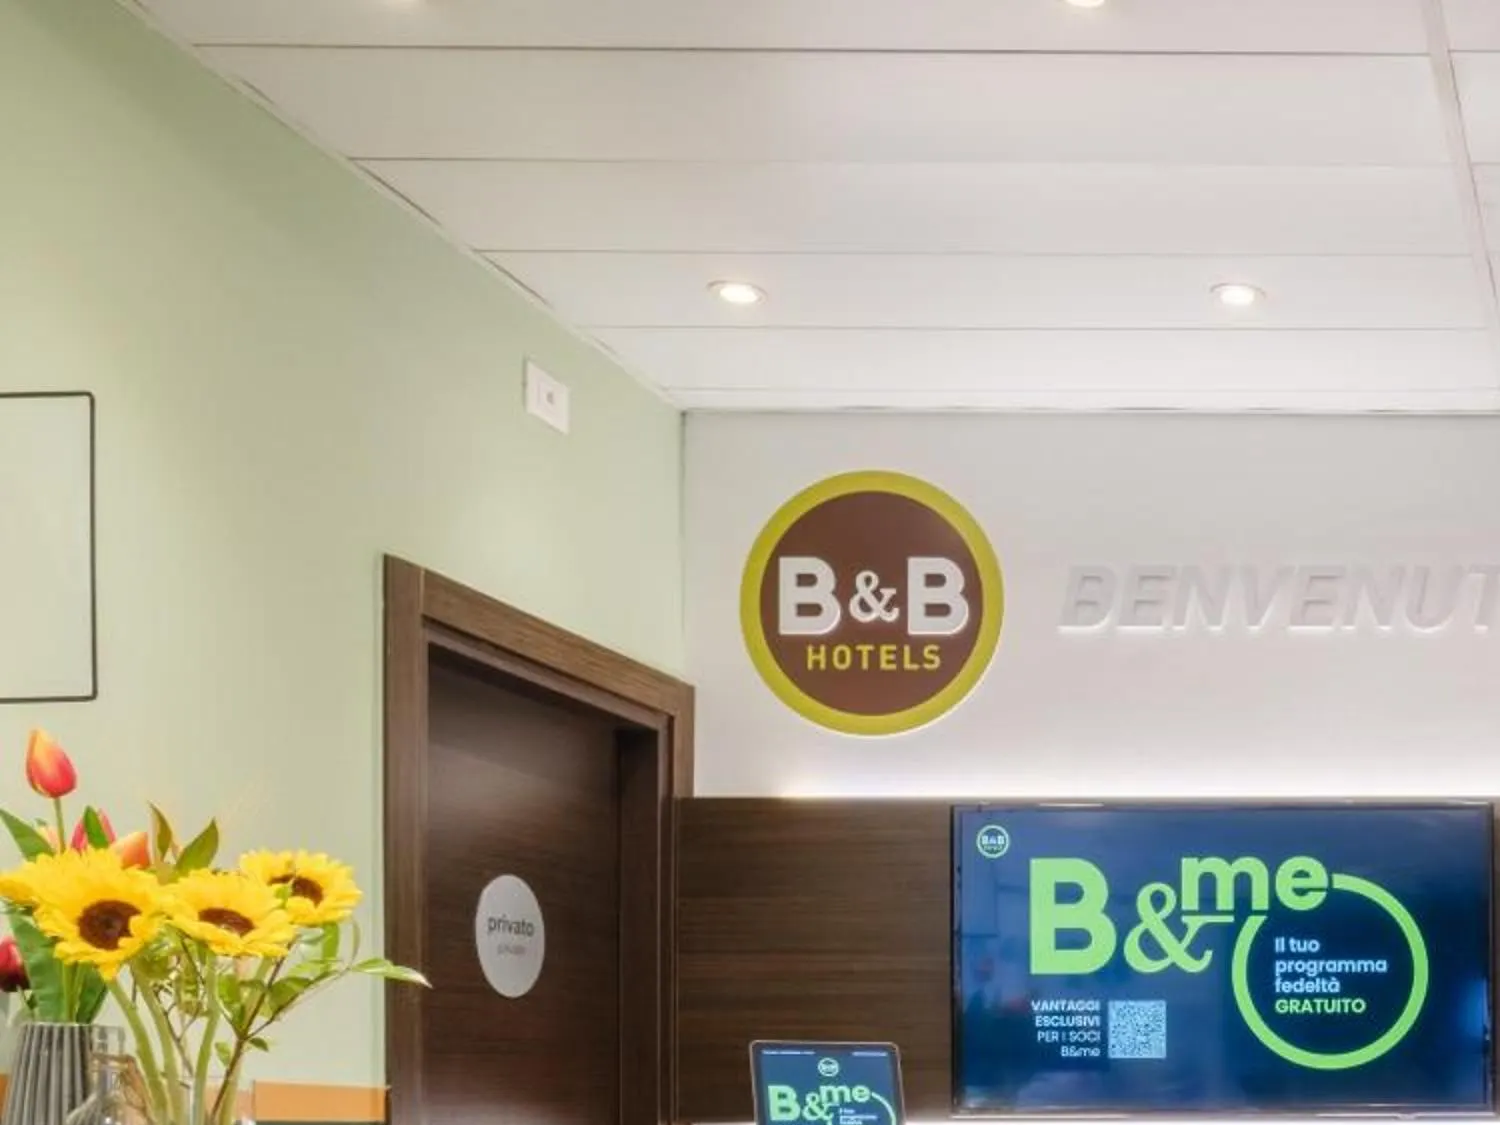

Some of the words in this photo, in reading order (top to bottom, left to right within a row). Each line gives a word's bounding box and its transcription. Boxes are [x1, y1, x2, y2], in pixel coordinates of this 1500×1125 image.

[777, 556, 971, 637] B&B
[805, 643, 942, 672] HOTELS
[1029, 856, 1329, 975] B&me
[487, 914, 535, 938] privato
[1274, 937, 1285, 953] Il
[1289, 937, 1320, 953] tuo
[1275, 959, 1388, 977] programma
[1274, 977, 1340, 993] fedeltà
[1031, 1000, 1101, 1011] VANTAGGI
[1274, 998, 1367, 1014] GRATUITO
[1035, 1015, 1101, 1027] ESCLUSIVI
[1037, 1031, 1059, 1042] PER
[1069, 1031, 1101, 1042] SOCI
[768, 1084, 872, 1121] B&me
